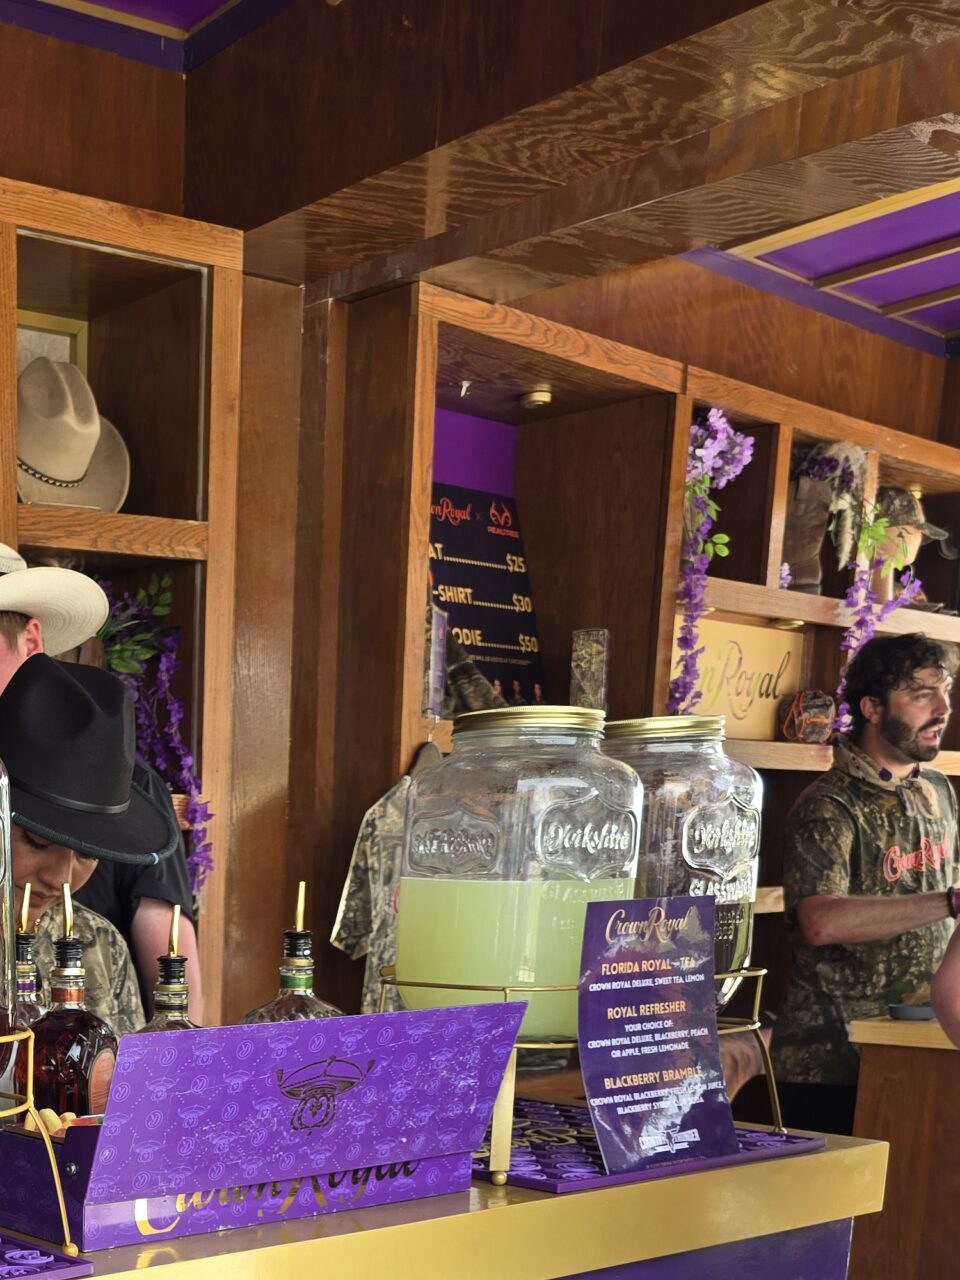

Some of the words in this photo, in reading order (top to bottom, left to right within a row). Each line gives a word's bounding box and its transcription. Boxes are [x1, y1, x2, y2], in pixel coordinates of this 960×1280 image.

[440, 497, 472, 526] Royal
[506, 552, 526, 573] $25
[431, 585, 474, 606] -SHIRT
[512, 592, 533, 613] $30
[451, 626, 482, 646] ODIE
[519, 633, 539, 654] $50
[700, 640, 791, 720] Royal
[543, 821, 631, 855] Yorkshire
[605, 908, 649, 945] Crown
[640, 906, 692, 943] Royal
[601, 963, 640, 976] FLORIDA
[642, 959, 671, 971] ROYAL
[589, 983, 611, 992] CROWN
[612, 981, 631, 990] ROYAL
[632, 979, 654, 989] DELUXE,
[655, 977, 672, 986] SWEET
[685, 974, 704, 982] LEMON
[607, 1006, 637, 1019] ROYAL
[640, 1001, 686, 1016] REFRESHER
[625, 1023, 642, 1033] YOUR
[642, 1021, 663, 1031] CHOICE
[588, 1039, 611, 1049] CROWN
[611, 1037, 631, 1046] ROYAL
[690, 1027, 708, 1037] PEACH
[611, 1050, 622, 1058] OR
[622, 1047, 640, 1057] APPLE,
[641, 1045, 658, 1055] FRESH
[659, 1042, 689, 1053] LEMONADE
[604, 1071, 660, 1089] BLACKBERRY
[590, 1097, 613, 1106] CROWN
[614, 1094, 633, 1104] ROYAL
[617, 1103, 652, 1115] BLACKBERRY
